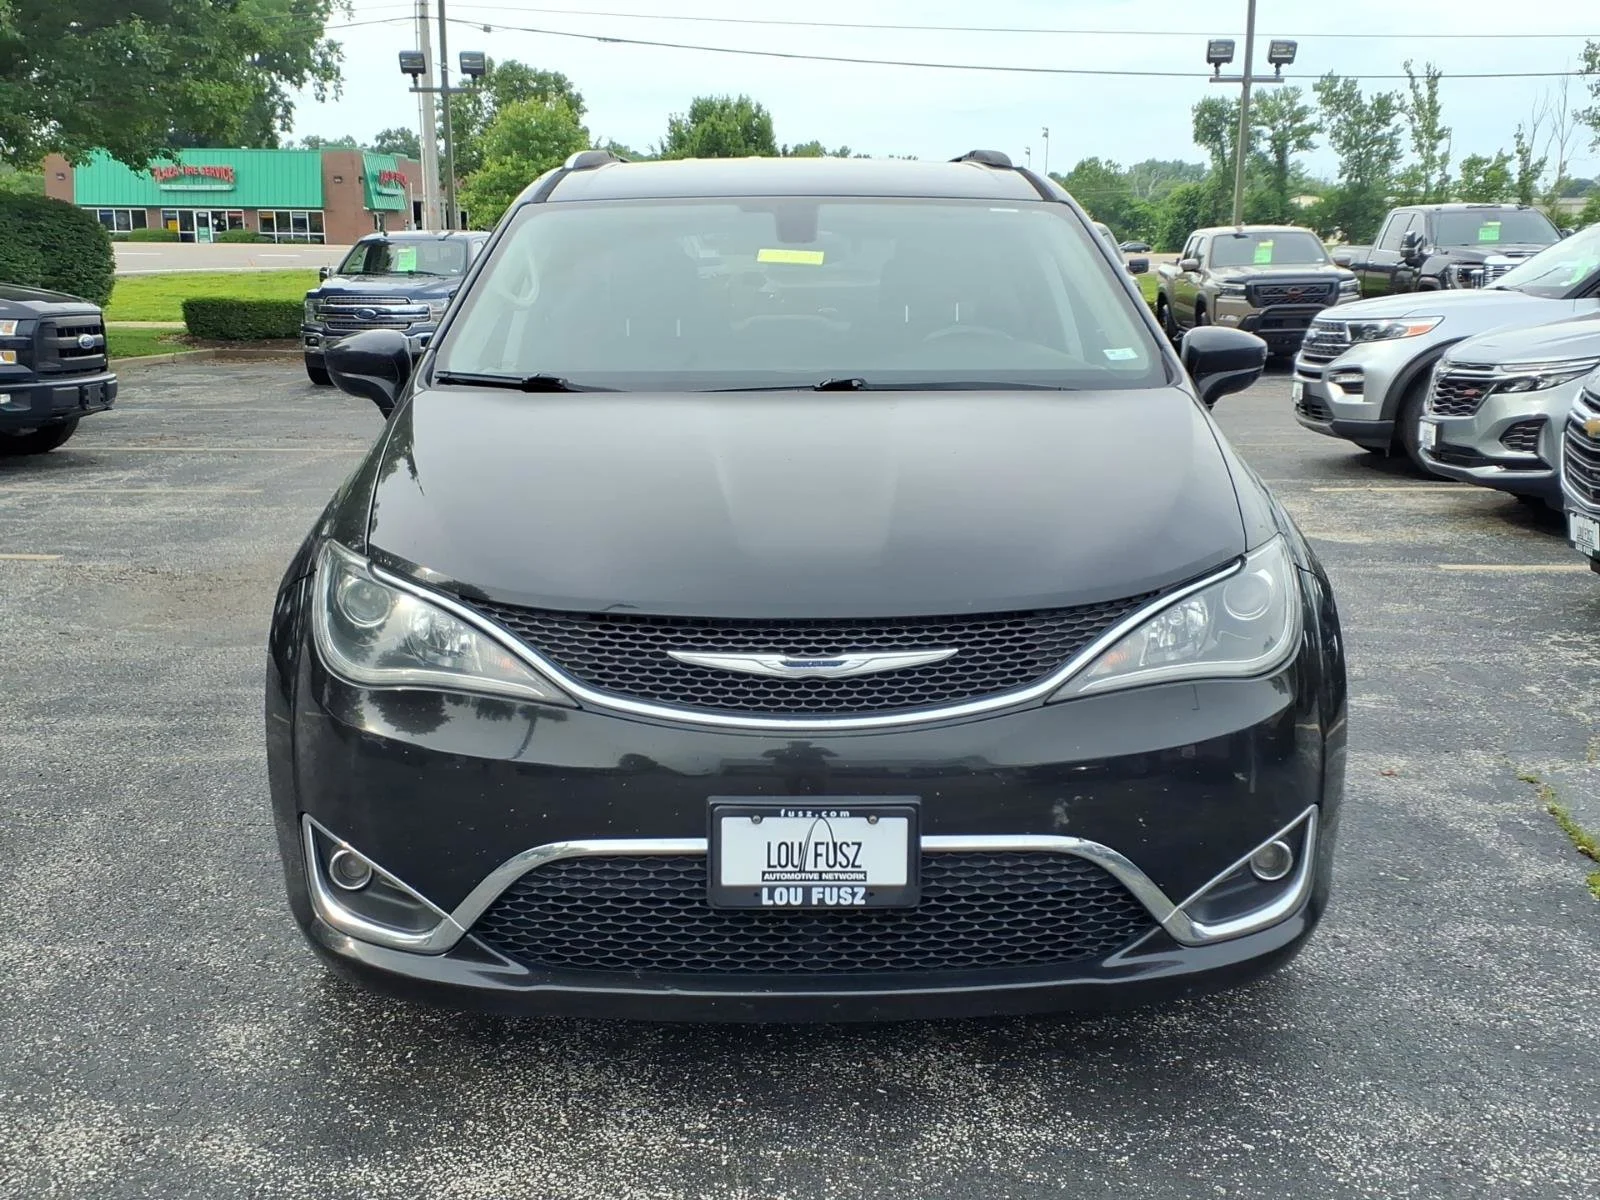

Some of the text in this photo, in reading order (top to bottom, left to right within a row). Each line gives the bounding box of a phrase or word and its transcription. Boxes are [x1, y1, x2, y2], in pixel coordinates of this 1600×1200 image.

[199, 165, 234, 182] SERVICE
[780, 808, 850, 818] fusz.com
[767, 841, 862, 869] LOU FUSZ
[763, 872, 865, 881] AUTOMOTIVE NETWORK
[762, 887, 866, 905] LOU FUSZ
